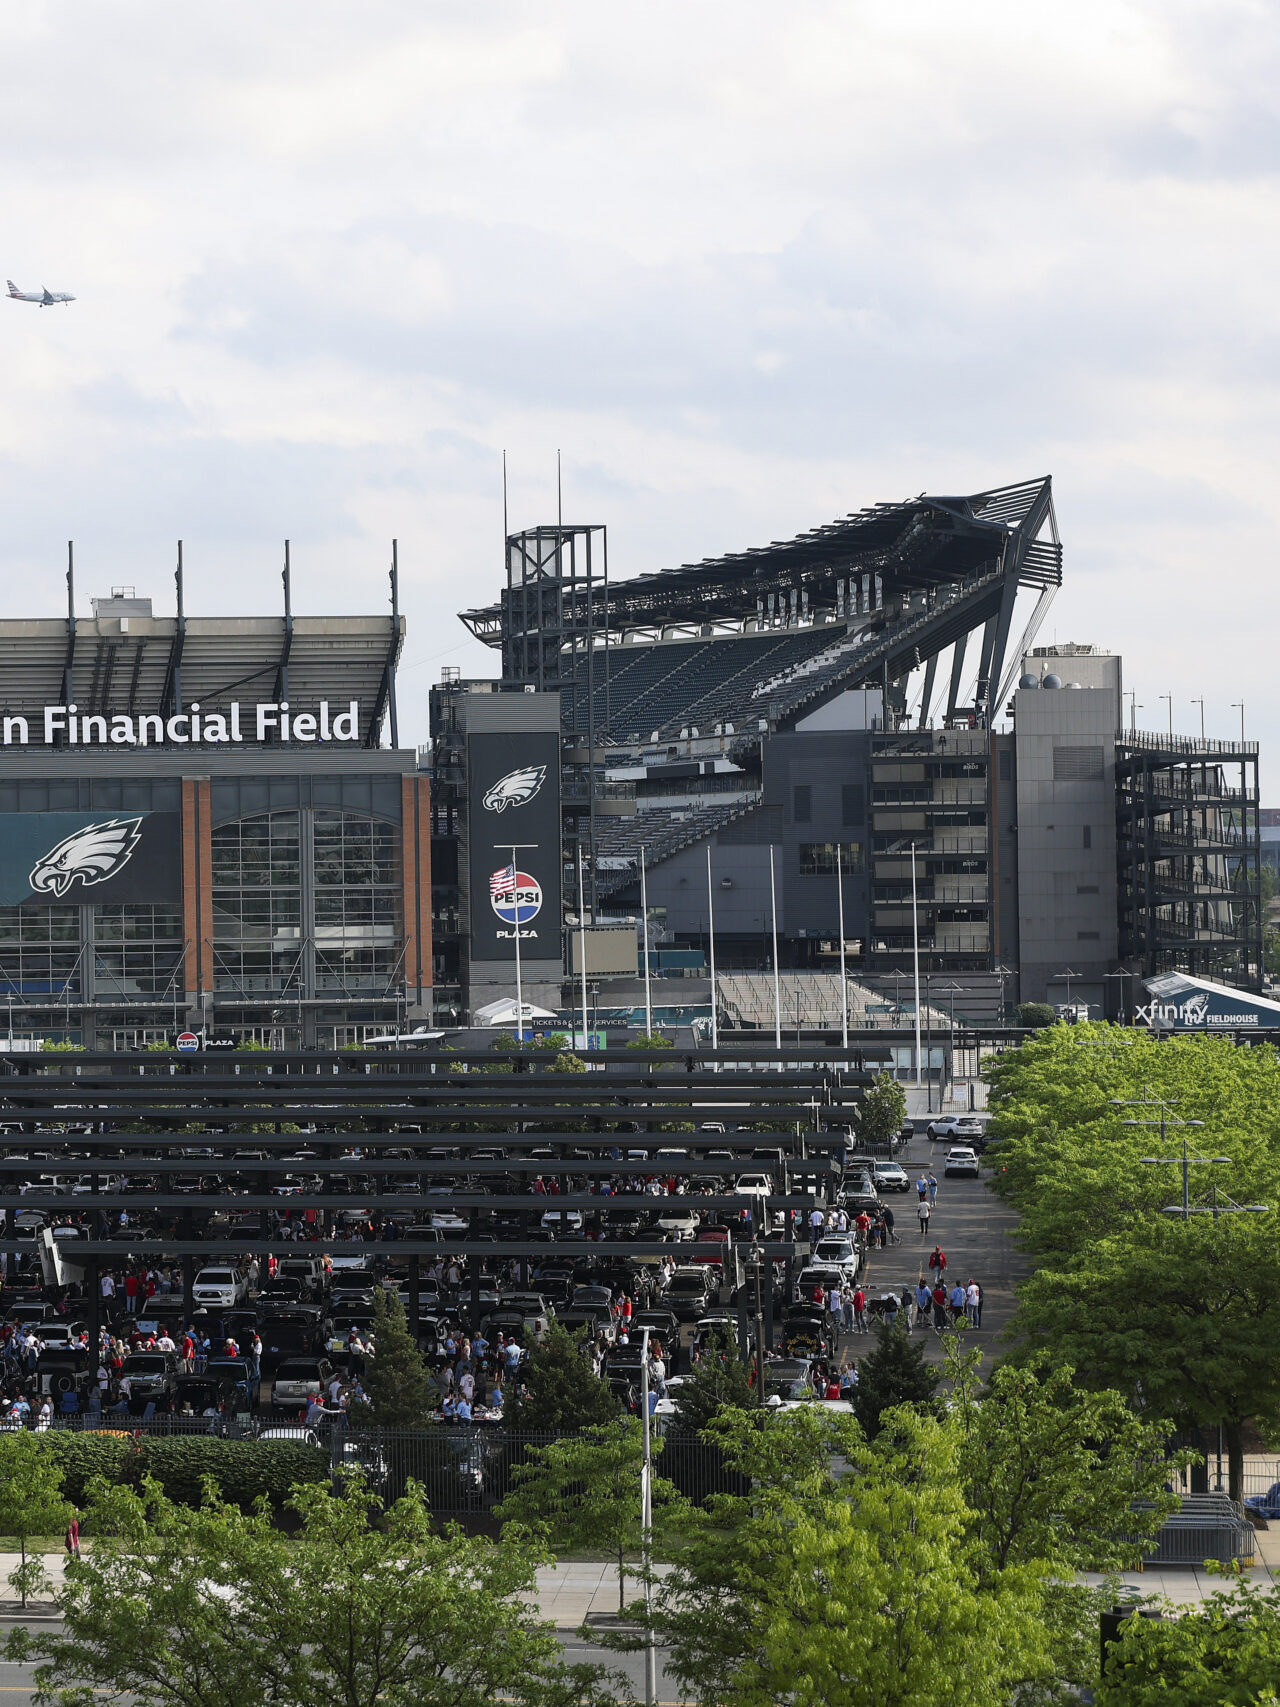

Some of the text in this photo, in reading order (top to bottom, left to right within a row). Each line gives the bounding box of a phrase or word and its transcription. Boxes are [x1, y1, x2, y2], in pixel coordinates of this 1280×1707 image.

[44, 702, 242, 744] Financial
[256, 700, 359, 742] Field
[495, 893, 539, 903] PEPSI
[496, 931, 538, 939] PLAZA
[1135, 999, 1209, 1025] xfinity
[1207, 1014, 1259, 1023] FIELDHOUSE
